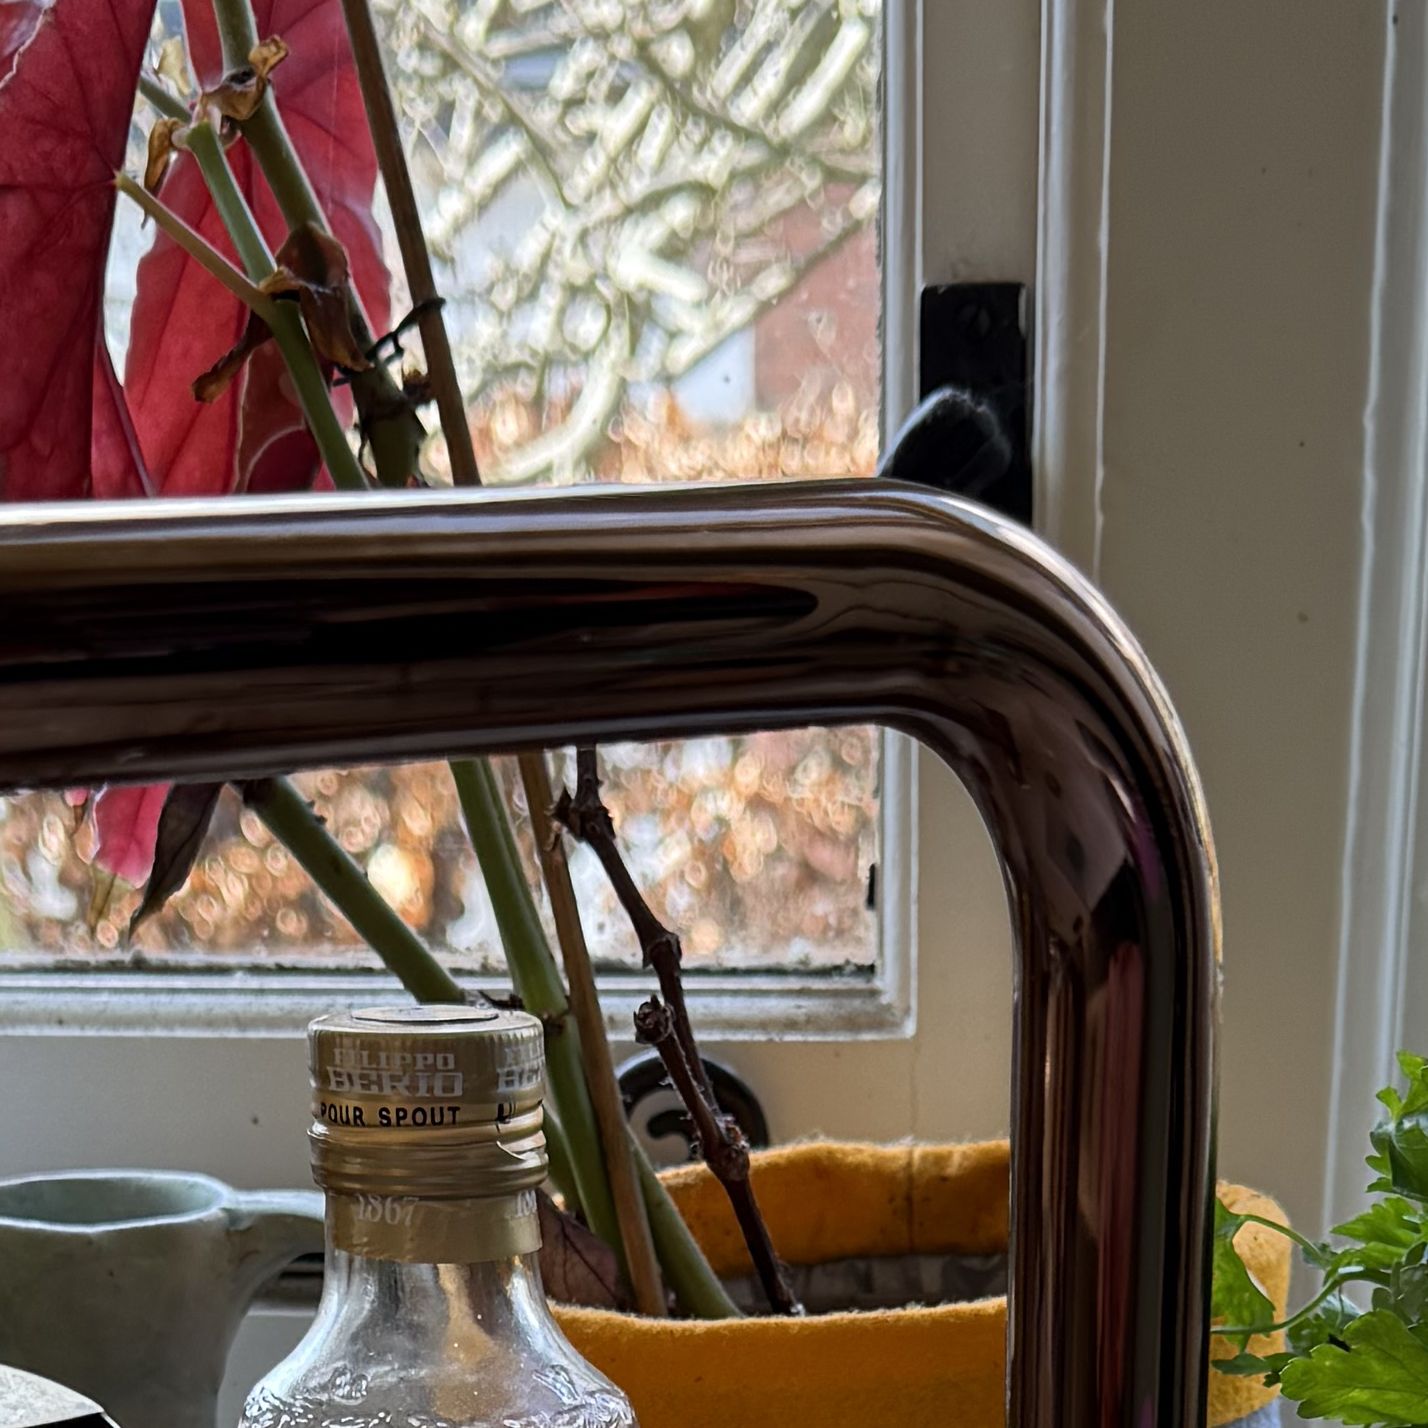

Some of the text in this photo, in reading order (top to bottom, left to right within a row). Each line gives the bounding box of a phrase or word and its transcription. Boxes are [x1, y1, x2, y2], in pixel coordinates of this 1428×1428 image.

[326, 1066, 464, 1098] BERIO
[320, 1101, 461, 1128] POUR SPOUT
